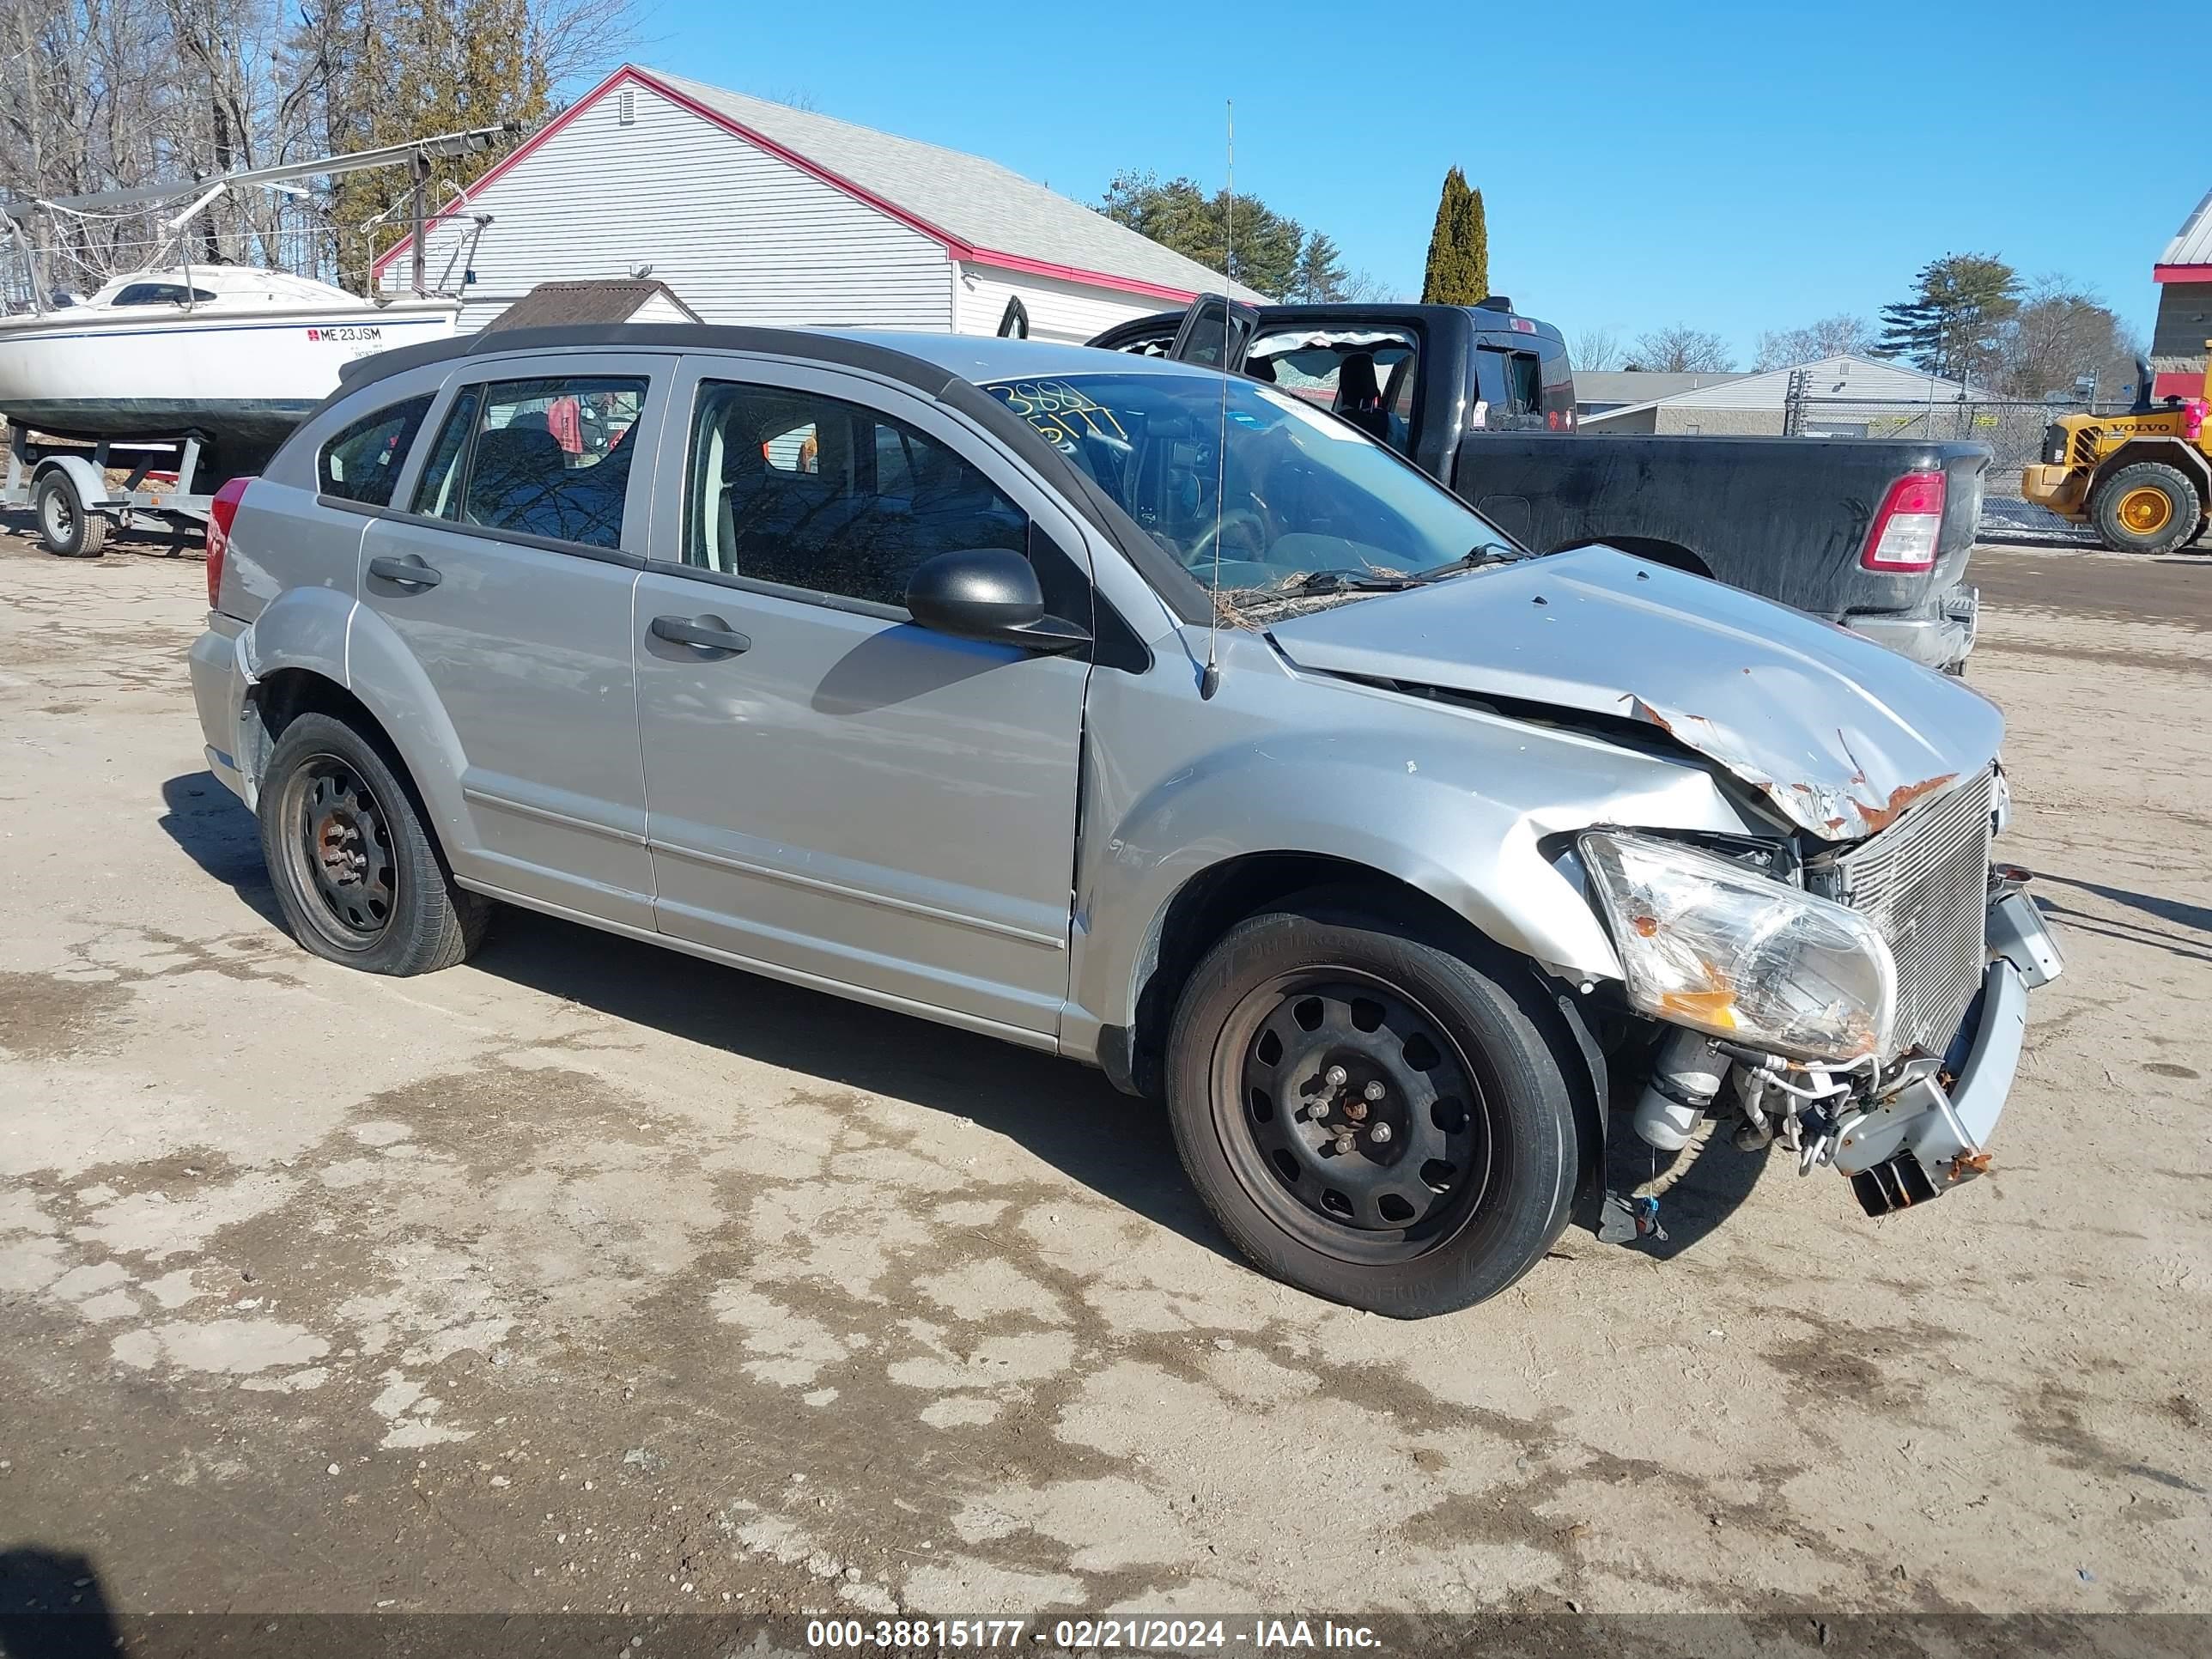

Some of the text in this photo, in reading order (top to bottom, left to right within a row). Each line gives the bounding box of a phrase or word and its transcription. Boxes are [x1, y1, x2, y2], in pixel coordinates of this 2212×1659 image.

[320, 329, 338, 341] ME
[987, 380, 1097, 416] 3881
[1027, 406, 1128, 444] 5177
[2111, 423, 2170, 432] VOLVO
